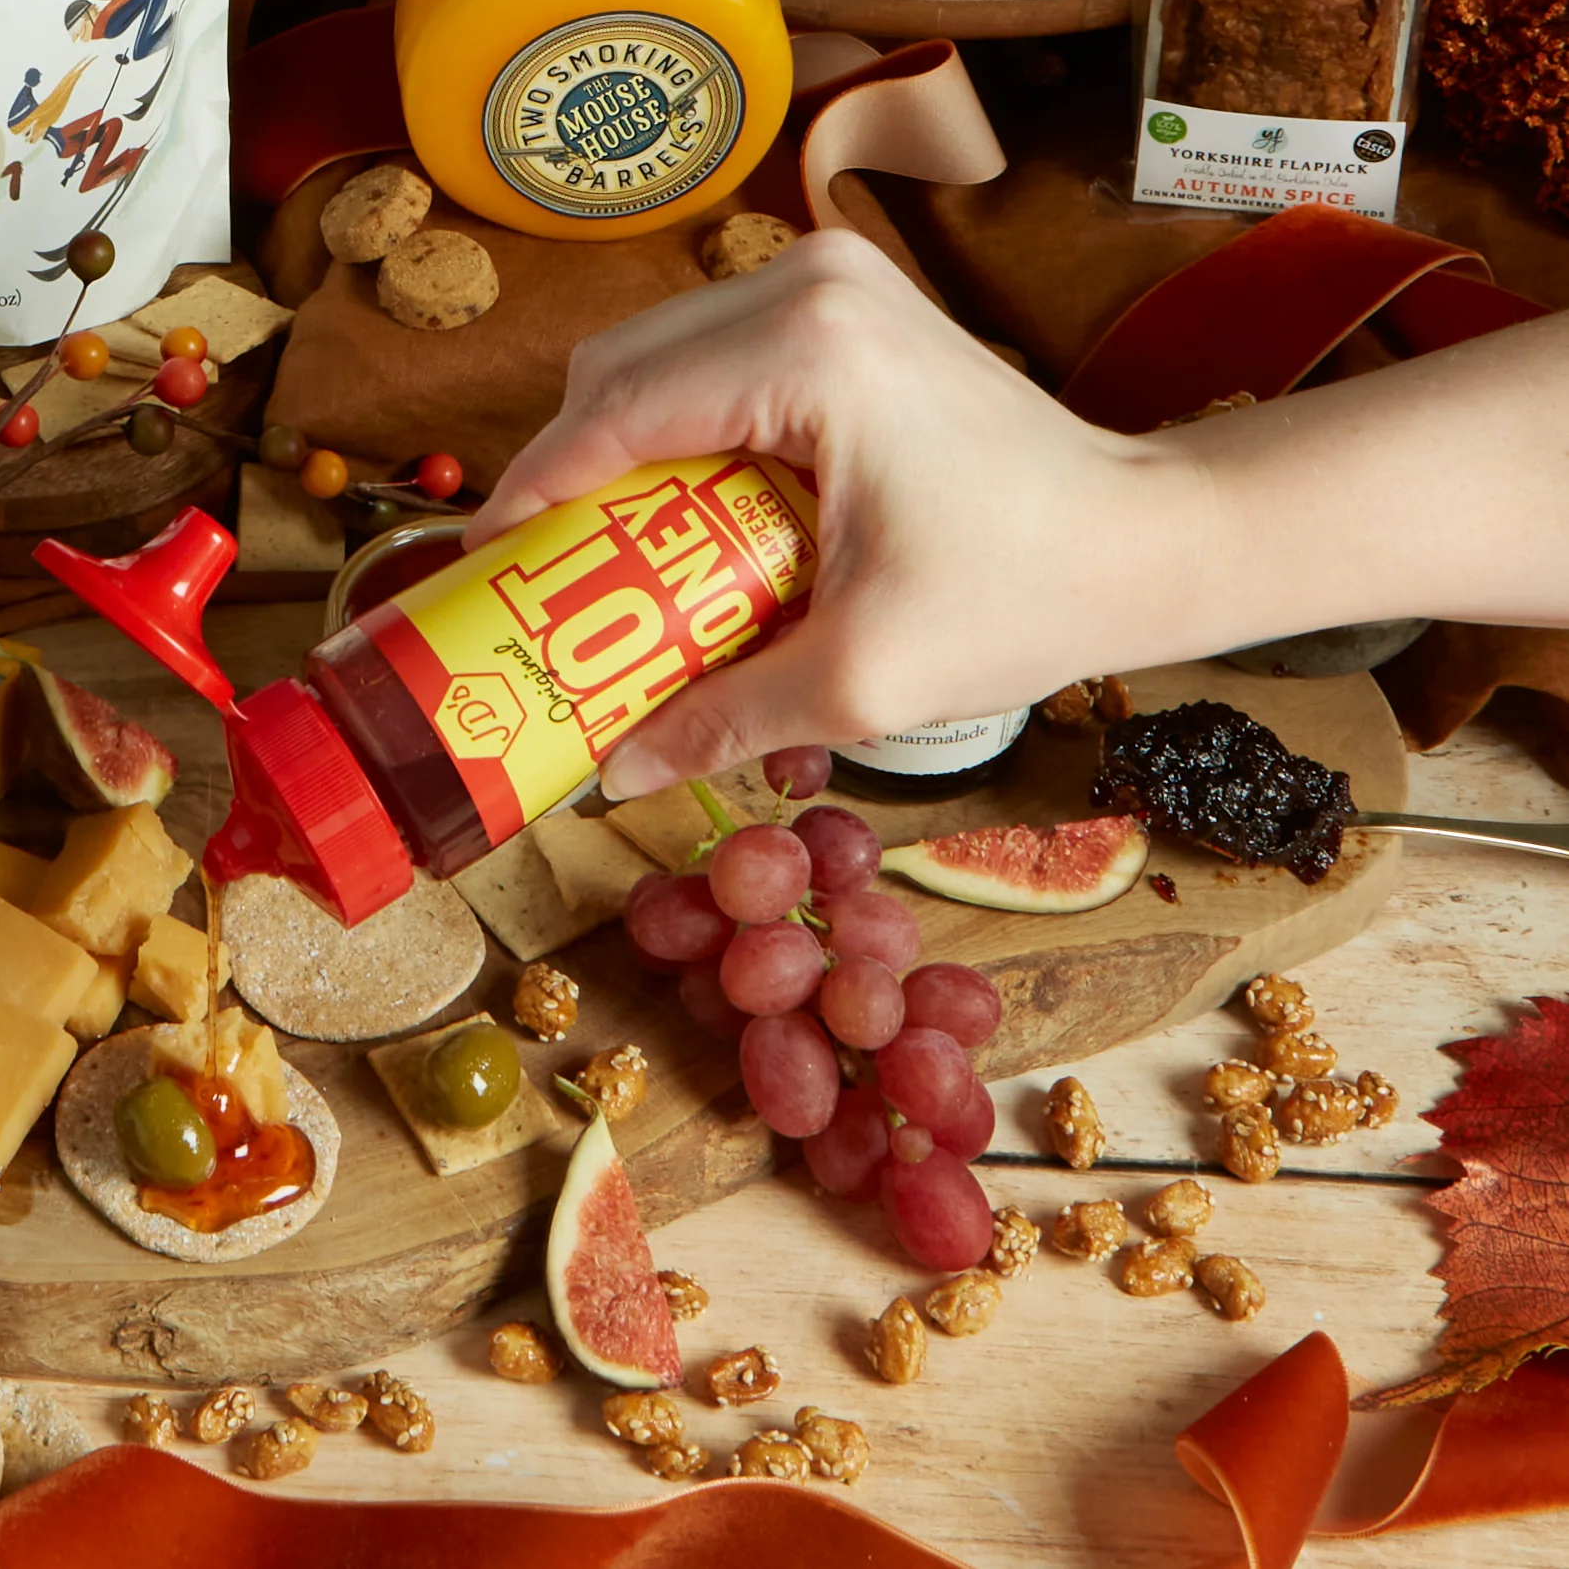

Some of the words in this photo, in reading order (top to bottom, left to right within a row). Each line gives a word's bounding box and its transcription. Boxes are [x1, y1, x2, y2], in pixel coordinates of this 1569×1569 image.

[519, 87, 553, 147] TWO
[547, 43, 695, 87] SMOKING
[557, 75, 651, 141] MOUSE
[583, 75, 614, 98] THE
[564, 119, 706, 190] BARRELS
[577, 99, 667, 165] HOUSE
[1170, 147, 1274, 168] YORKSHIRE
[1280, 159, 1369, 175] FLAPJACK
[1356, 137, 1392, 157] taste
[1173, 177, 1277, 199] AUTUMN
[1284, 189, 1357, 206] SPICE
[733, 495, 797, 587] JALAPEÑO
[755, 490, 814, 567] INFUSED
[492, 531, 689, 755] HOT
[494, 636, 576, 723] Original
